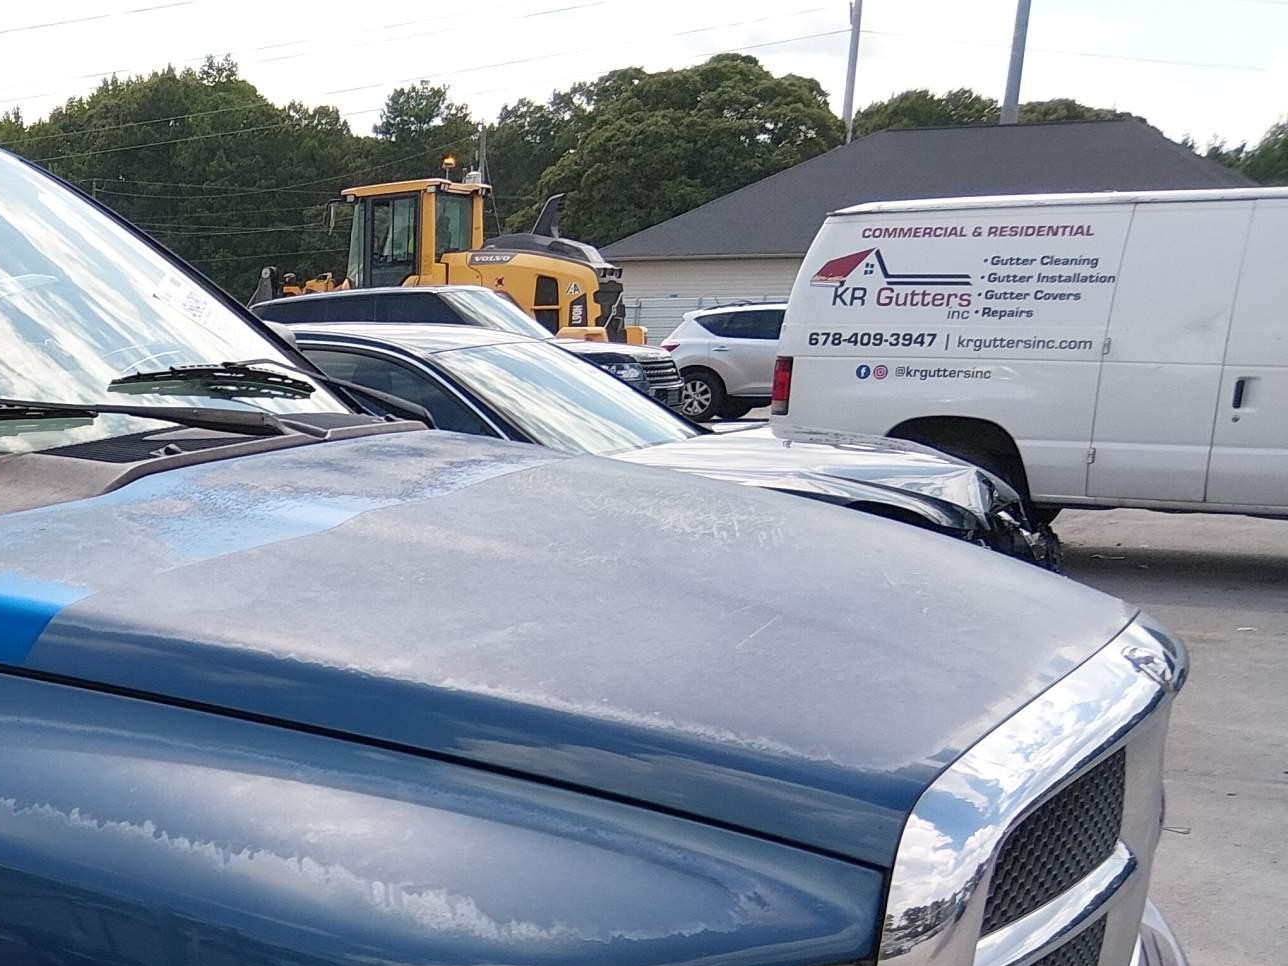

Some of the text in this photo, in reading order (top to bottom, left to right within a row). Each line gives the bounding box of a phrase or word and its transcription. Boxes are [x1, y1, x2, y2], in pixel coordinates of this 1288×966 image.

[862, 224, 1095, 239] COMMERCIAL & RESIDENTIAL
[473, 254, 511, 263] VOLVO
[990, 254, 1099, 268] Gutter Cleaning
[987, 272, 1116, 284] Gutter Installation
[832, 286, 972, 307] KR Gutters
[984, 289, 1081, 301] Gutter Covers
[946, 306, 970, 320] inc
[981, 306, 1034, 320] Repairs
[808, 332, 938, 347] 678-409-3947
[957, 335, 1094, 351] krguttersinc.com
[895, 365, 992, 380] @krguttersinc
